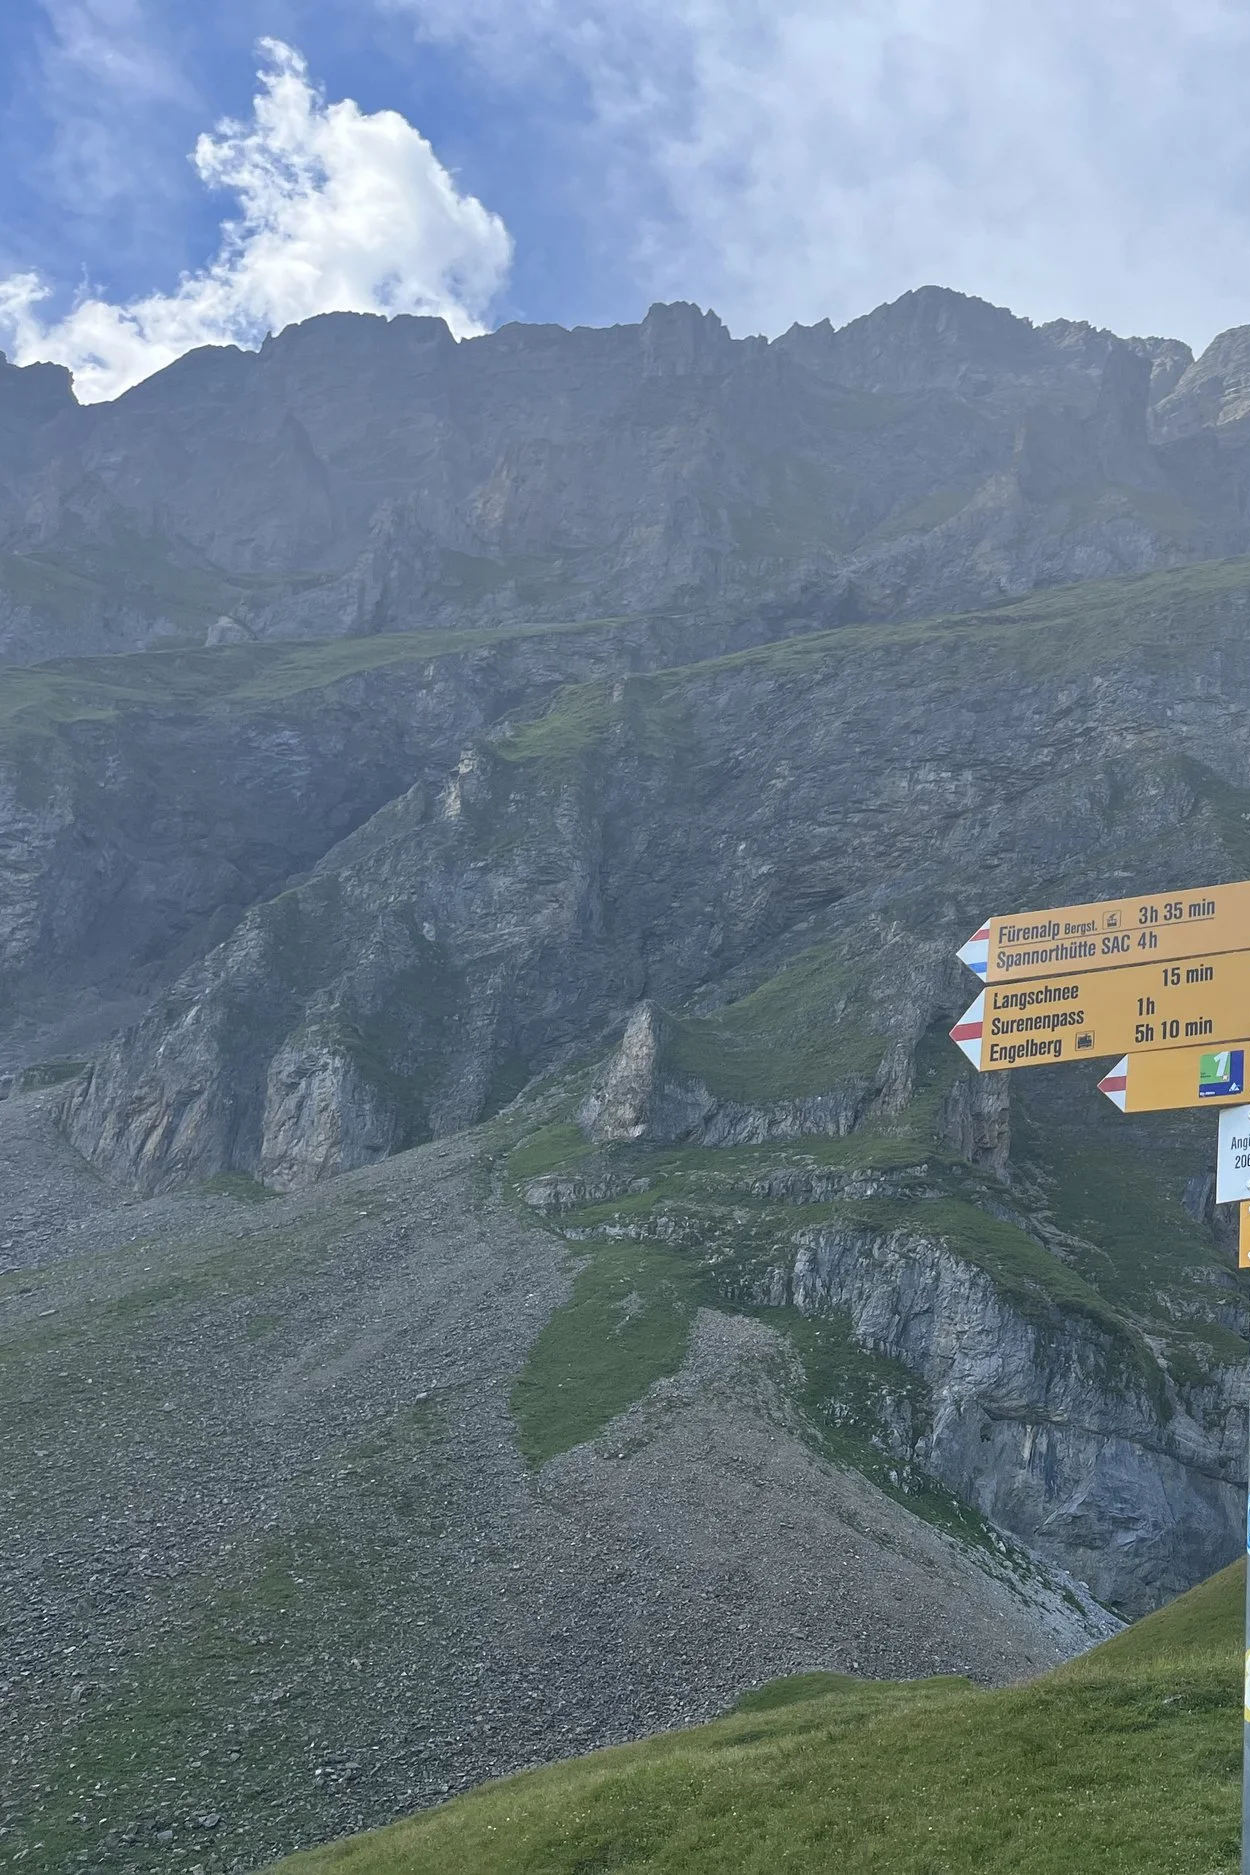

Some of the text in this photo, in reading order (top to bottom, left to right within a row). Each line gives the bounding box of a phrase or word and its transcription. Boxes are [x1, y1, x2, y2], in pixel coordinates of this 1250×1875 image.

[999, 920, 1060, 944] Fürenalp
[1064, 920, 1098, 935] Bergst.
[1164, 902, 1183, 921] 35
[1188, 899, 1215, 918] min
[996, 941, 1096, 971] Spannorthütte
[1101, 934, 1130, 955] SAC
[993, 963, 1213, 1010] Langschnee 15 min
[989, 1039, 1062, 1063] Engelberg
[1161, 1019, 1180, 1040] 10
[1185, 1016, 1213, 1037] min
[991, 1010, 1085, 1036] Surenenpass
[1213, 1051, 1230, 1077] 1
